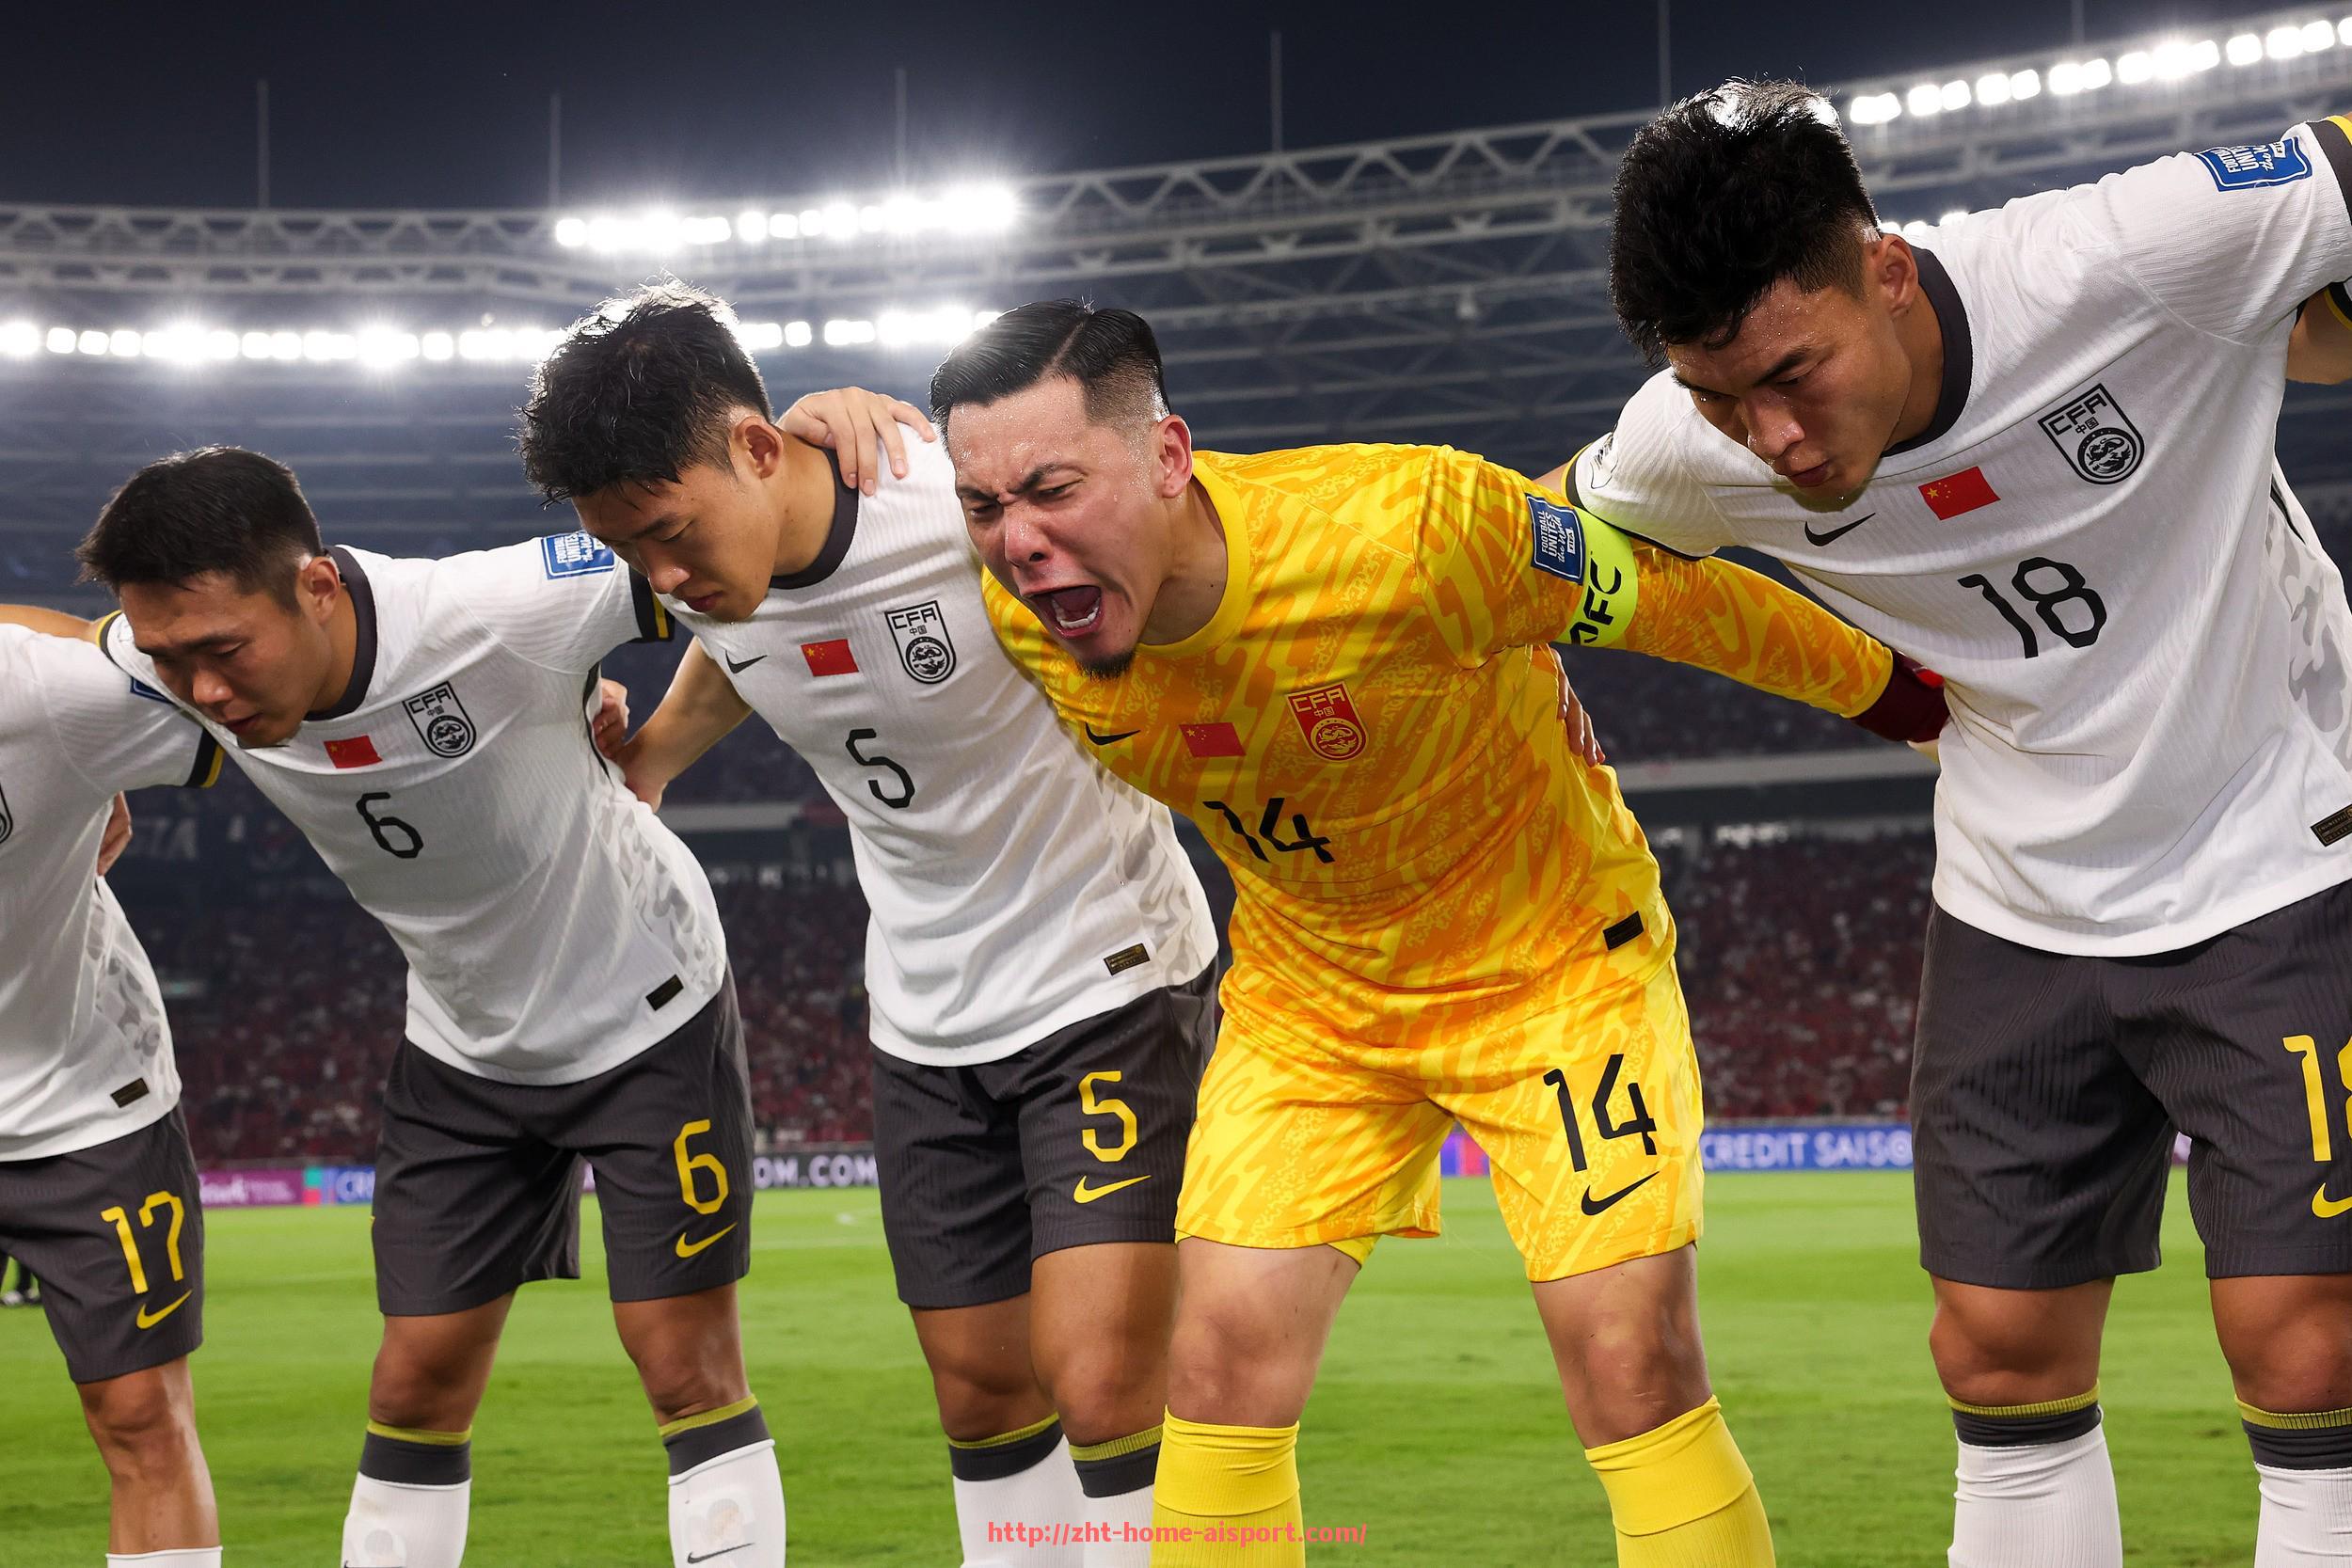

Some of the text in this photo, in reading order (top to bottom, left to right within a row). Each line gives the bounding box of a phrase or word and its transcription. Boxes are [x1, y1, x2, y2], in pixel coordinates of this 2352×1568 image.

[2048, 393, 2107, 436] CFA
[2075, 417, 2099, 434] 中国
[1537, 511, 1549, 553] FOOTBALL
[1545, 512, 1557, 557] UNITES
[891, 608, 937, 629] CFA
[1958, 556, 2107, 658] 18
[408, 688, 452, 714] CFA
[1293, 688, 1345, 712] CFA
[846, 728, 915, 809] 5
[356, 791, 423, 859] 6
[1202, 797, 1336, 863] 14
[1078, 1070, 1137, 1163] 5
[1543, 1053, 1657, 1172] 14
[673, 1118, 729, 1215] 6
[1699, 1132, 1808, 1168] CREDIT
[101, 1190, 185, 1294] 17
